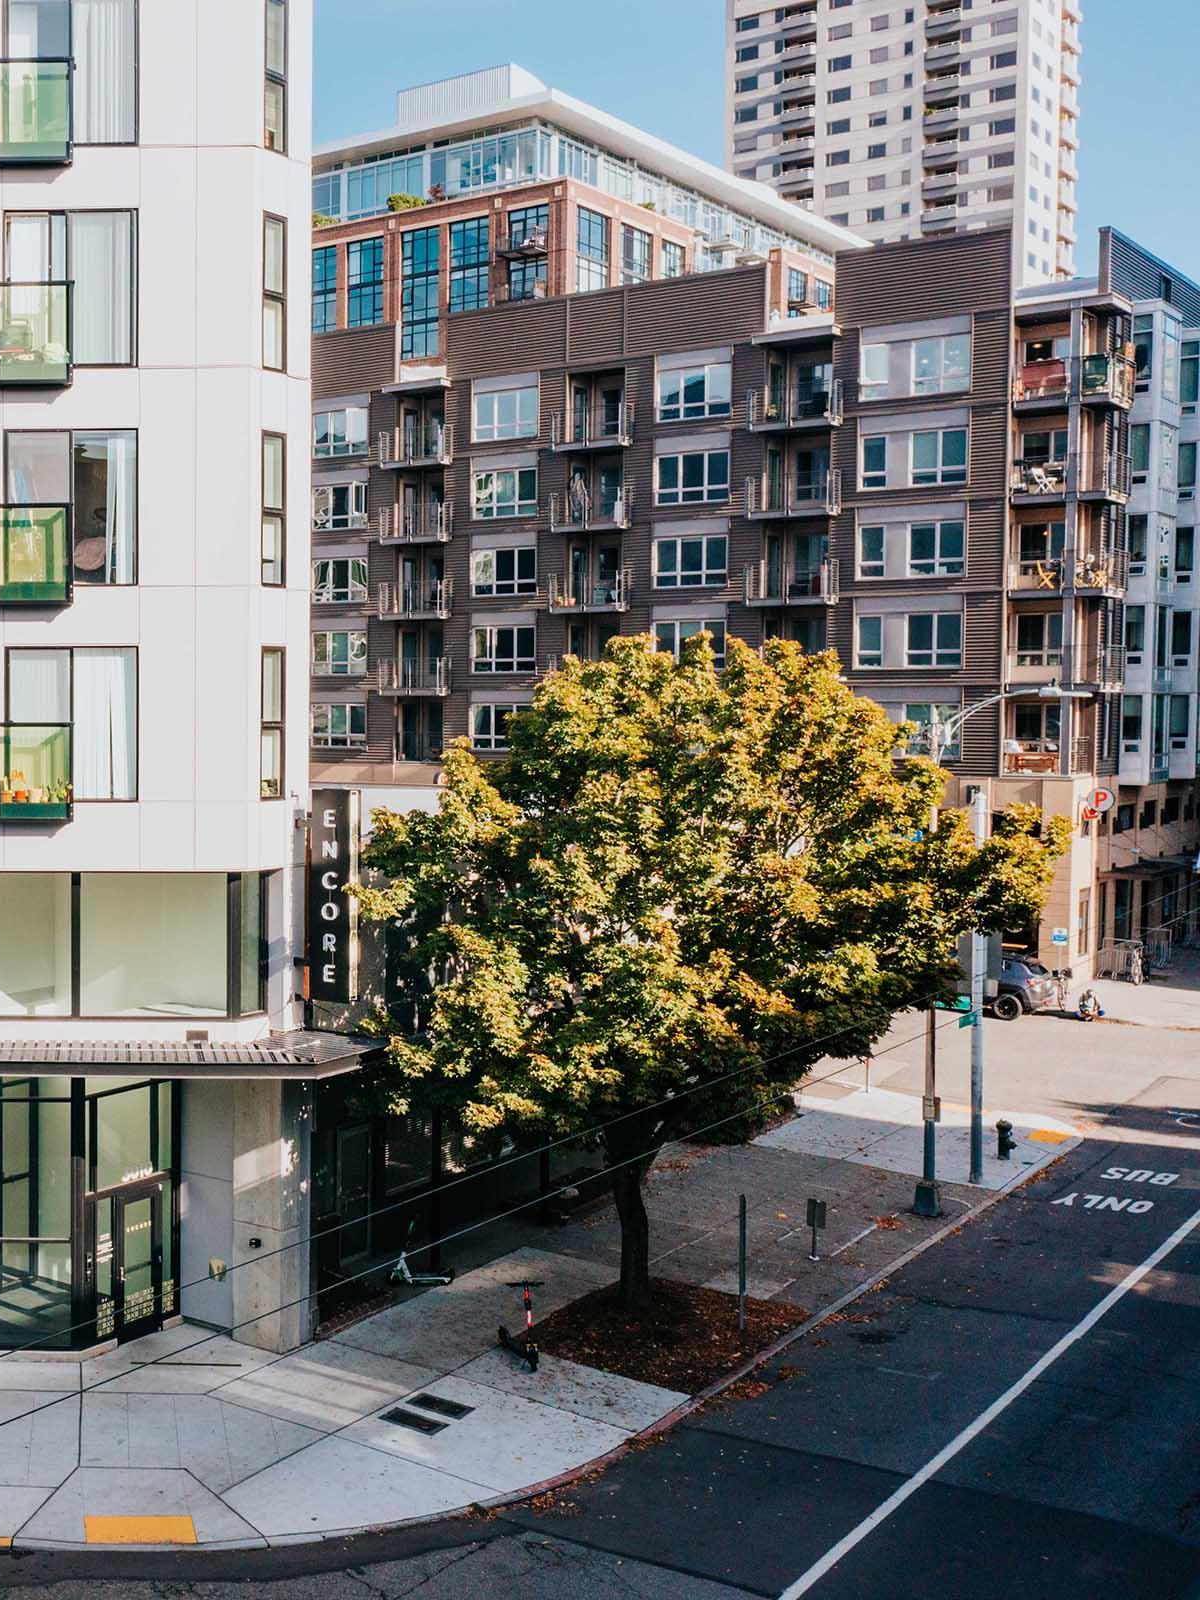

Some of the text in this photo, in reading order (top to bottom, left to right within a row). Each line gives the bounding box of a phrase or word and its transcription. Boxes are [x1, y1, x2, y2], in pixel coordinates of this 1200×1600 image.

[1095, 791, 1108, 808] P
[321, 808, 340, 984] ENCORE
[1100, 1167, 1180, 1186] BUS
[1050, 1192, 1154, 1214] ONLY
